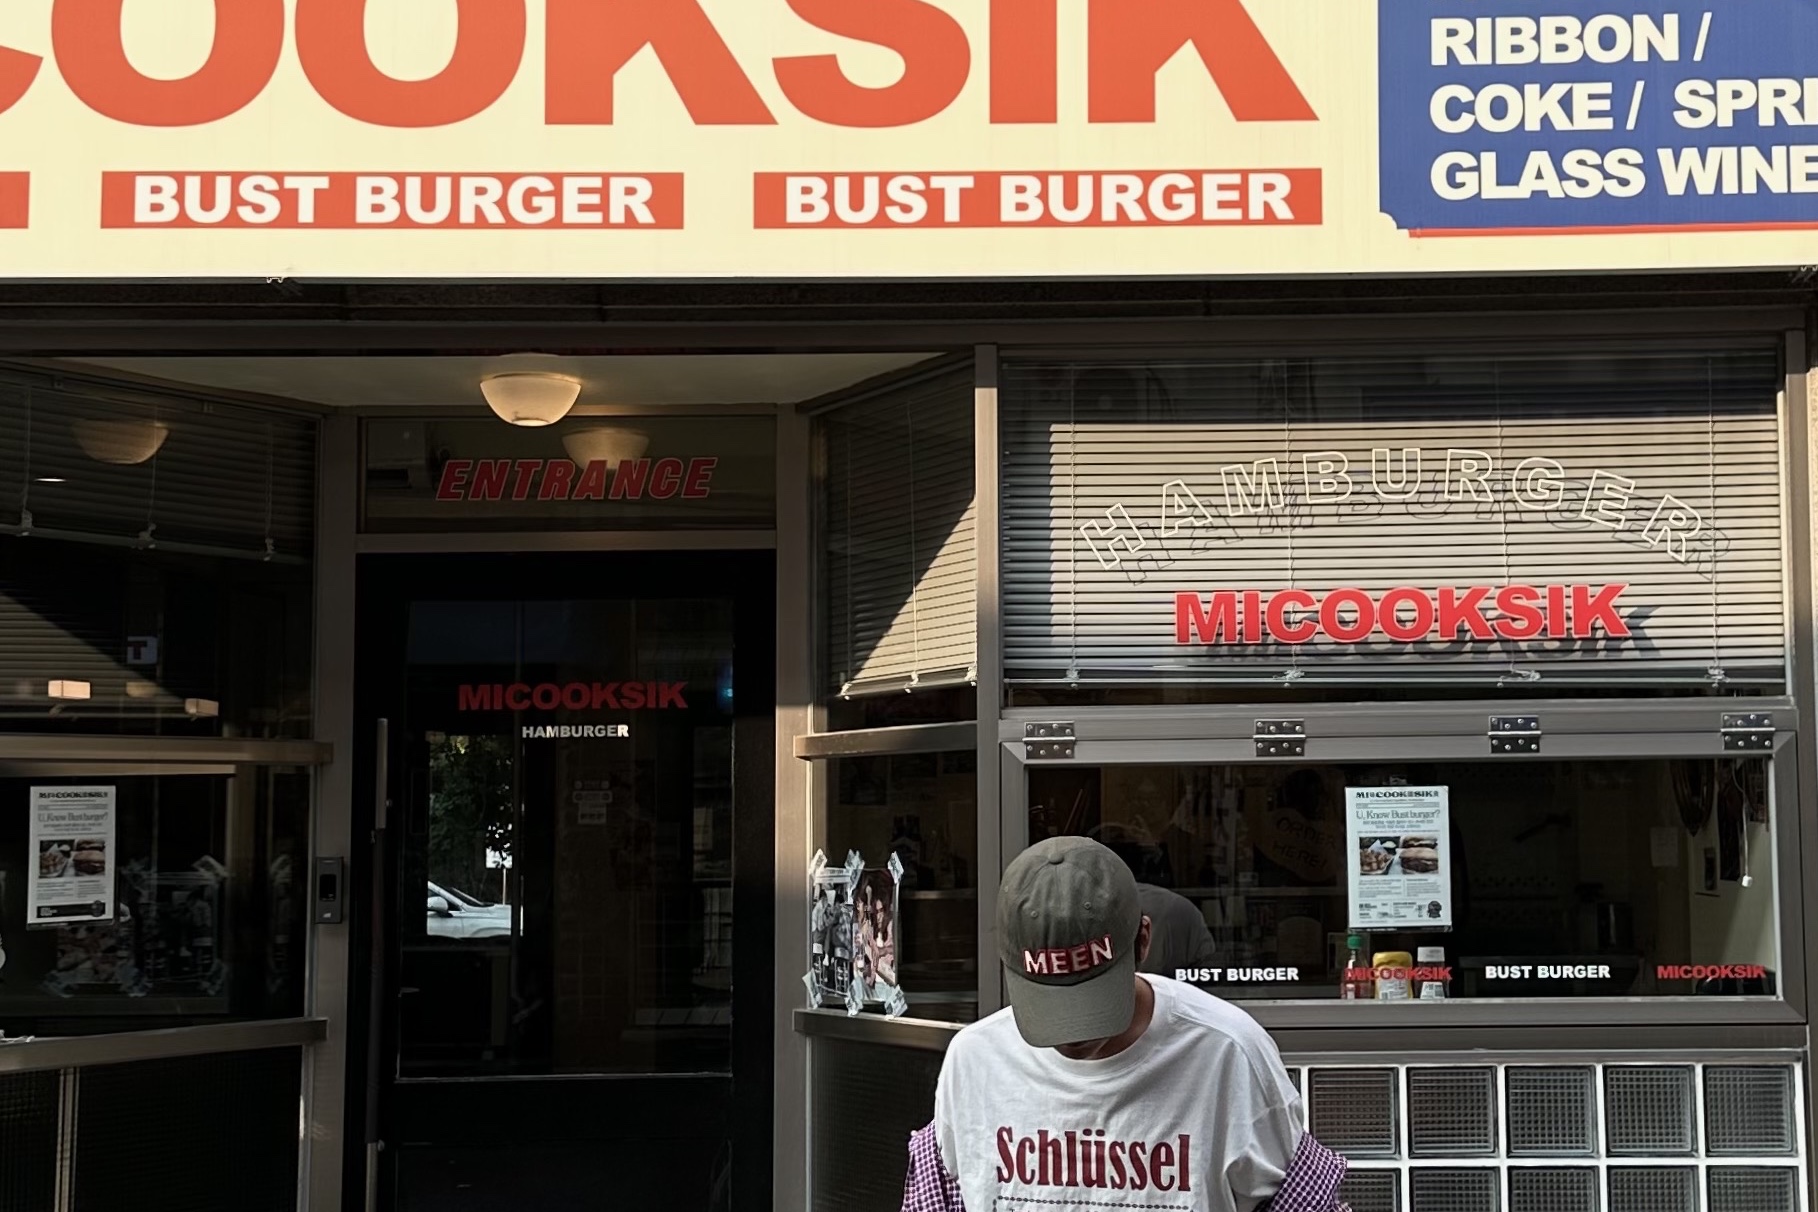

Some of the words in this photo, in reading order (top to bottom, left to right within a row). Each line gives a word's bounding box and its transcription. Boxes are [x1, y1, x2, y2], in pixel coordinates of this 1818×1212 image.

[0, 0, 1320, 128] OOKSIK
[1431, 13, 1680, 66] RIBBON
[1692, 12, 1712, 62] /
[1430, 82, 1614, 133] COKE
[1625, 80, 1645, 131] /
[1430, 148, 1647, 200] GLASS
[1657, 145, 1818, 196] WINE
[133, 175, 329, 225] BUST
[354, 175, 656, 225] BURGER
[785, 174, 984, 225] BUST
[999, 172, 1294, 223] BURGER
[436, 457, 718, 501] ENTRANCE
[1079, 447, 1703, 571] HAMBURGER
[1174, 582, 1632, 645] MICOOKSIK
[458, 681, 689, 712] MICOOKSIK
[522, 723, 630, 739] HAMBURGER
[1022, 934, 1114, 977] MEEN
[1175, 967, 1222, 983] BUST
[1226, 966, 1300, 982] BURGER
[1344, 967, 1453, 982] MICOOKSIK
[1484, 965, 1534, 980] BUST
[1537, 964, 1612, 980] BURGER
[1655, 964, 1768, 980] MICOOKSIK
[996, 1126, 1191, 1192] Schlüssel
